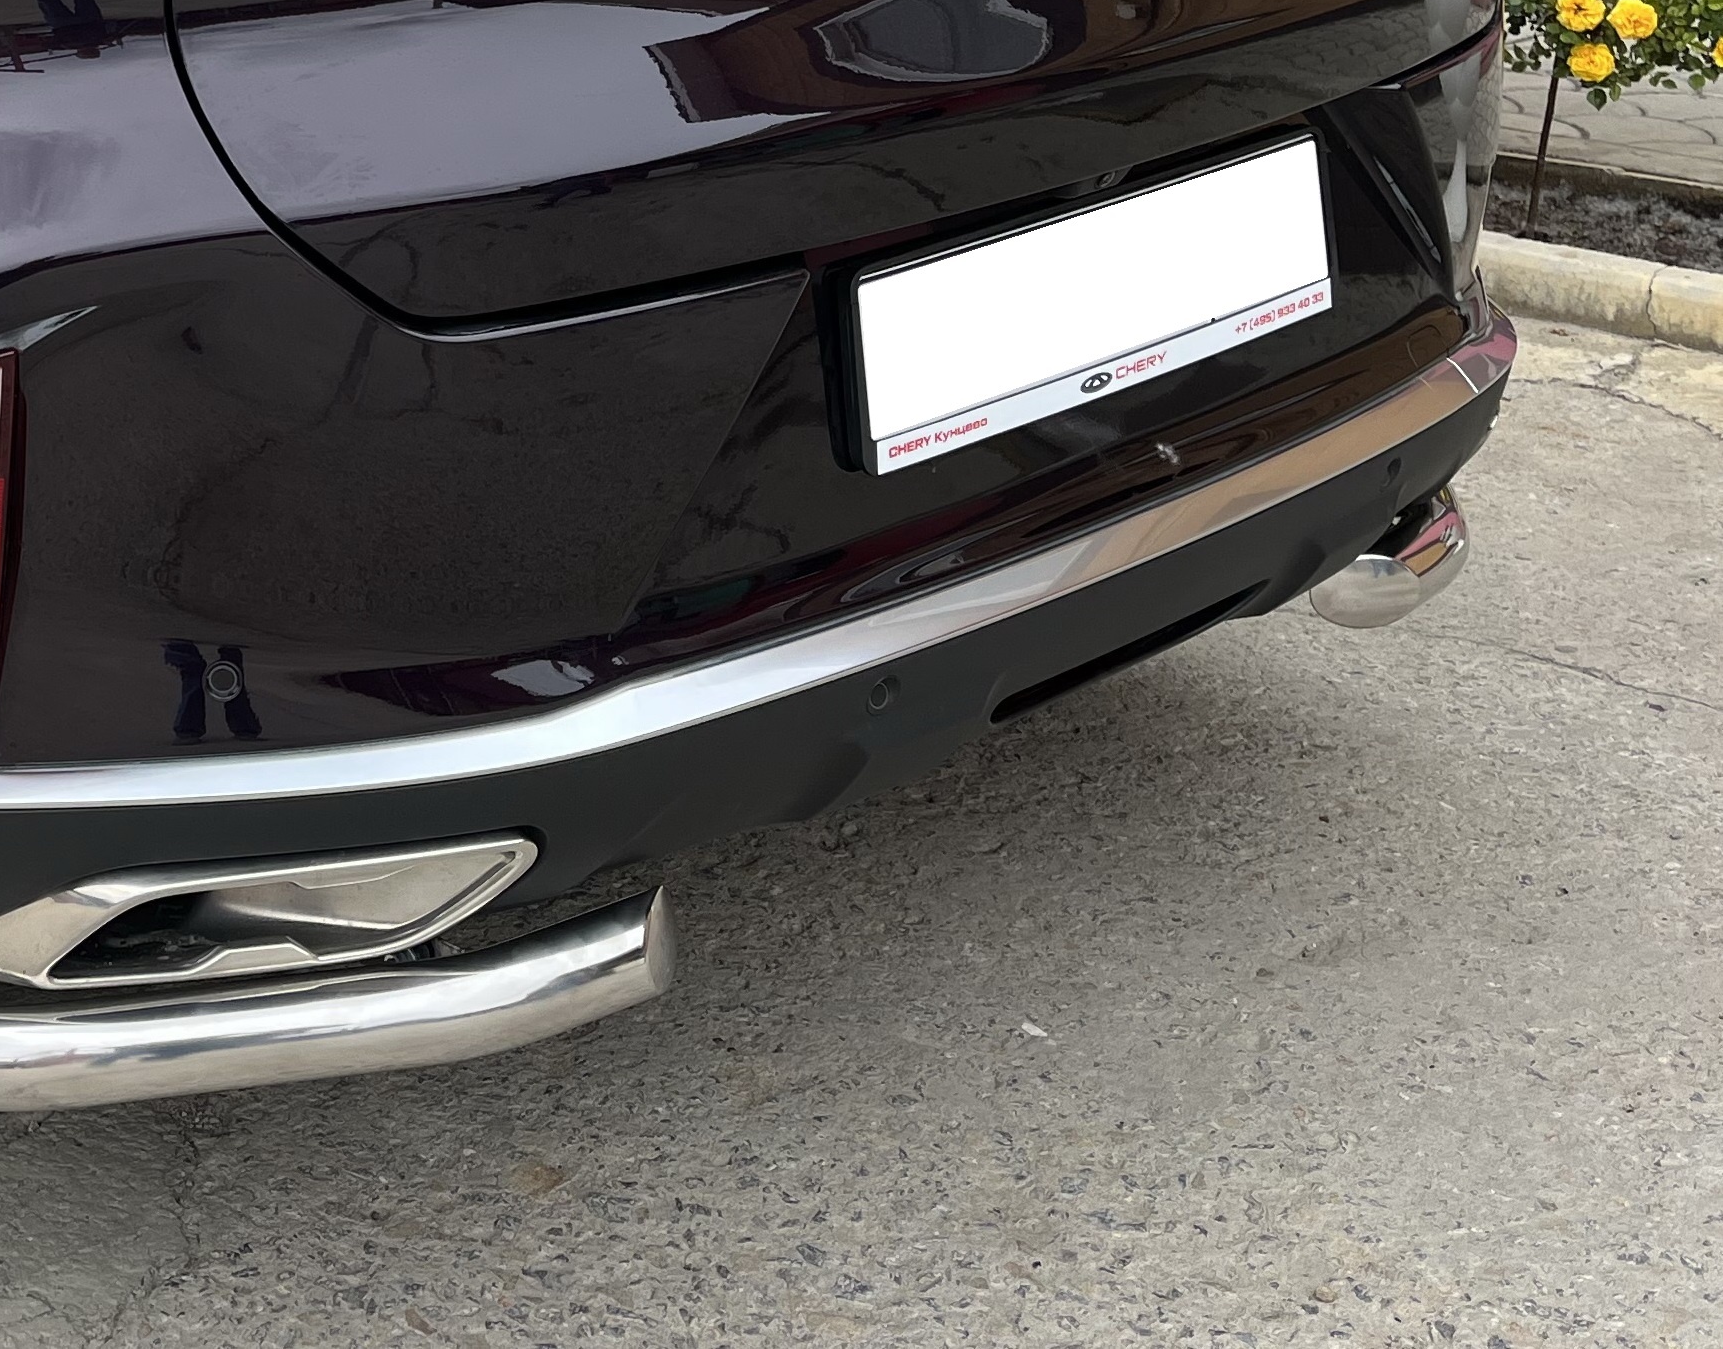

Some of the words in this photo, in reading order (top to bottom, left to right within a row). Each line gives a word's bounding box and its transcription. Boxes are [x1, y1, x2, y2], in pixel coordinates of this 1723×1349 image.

[1234, 321, 1248, 335] +7
[1277, 302, 1296, 319] 933
[1297, 296, 1310, 310] 40
[1311, 291, 1324, 305] 33
[1114, 350, 1167, 380] CHERY
[888, 434, 932, 459] CHERY
[934, 417, 988, 444] Кунцево
